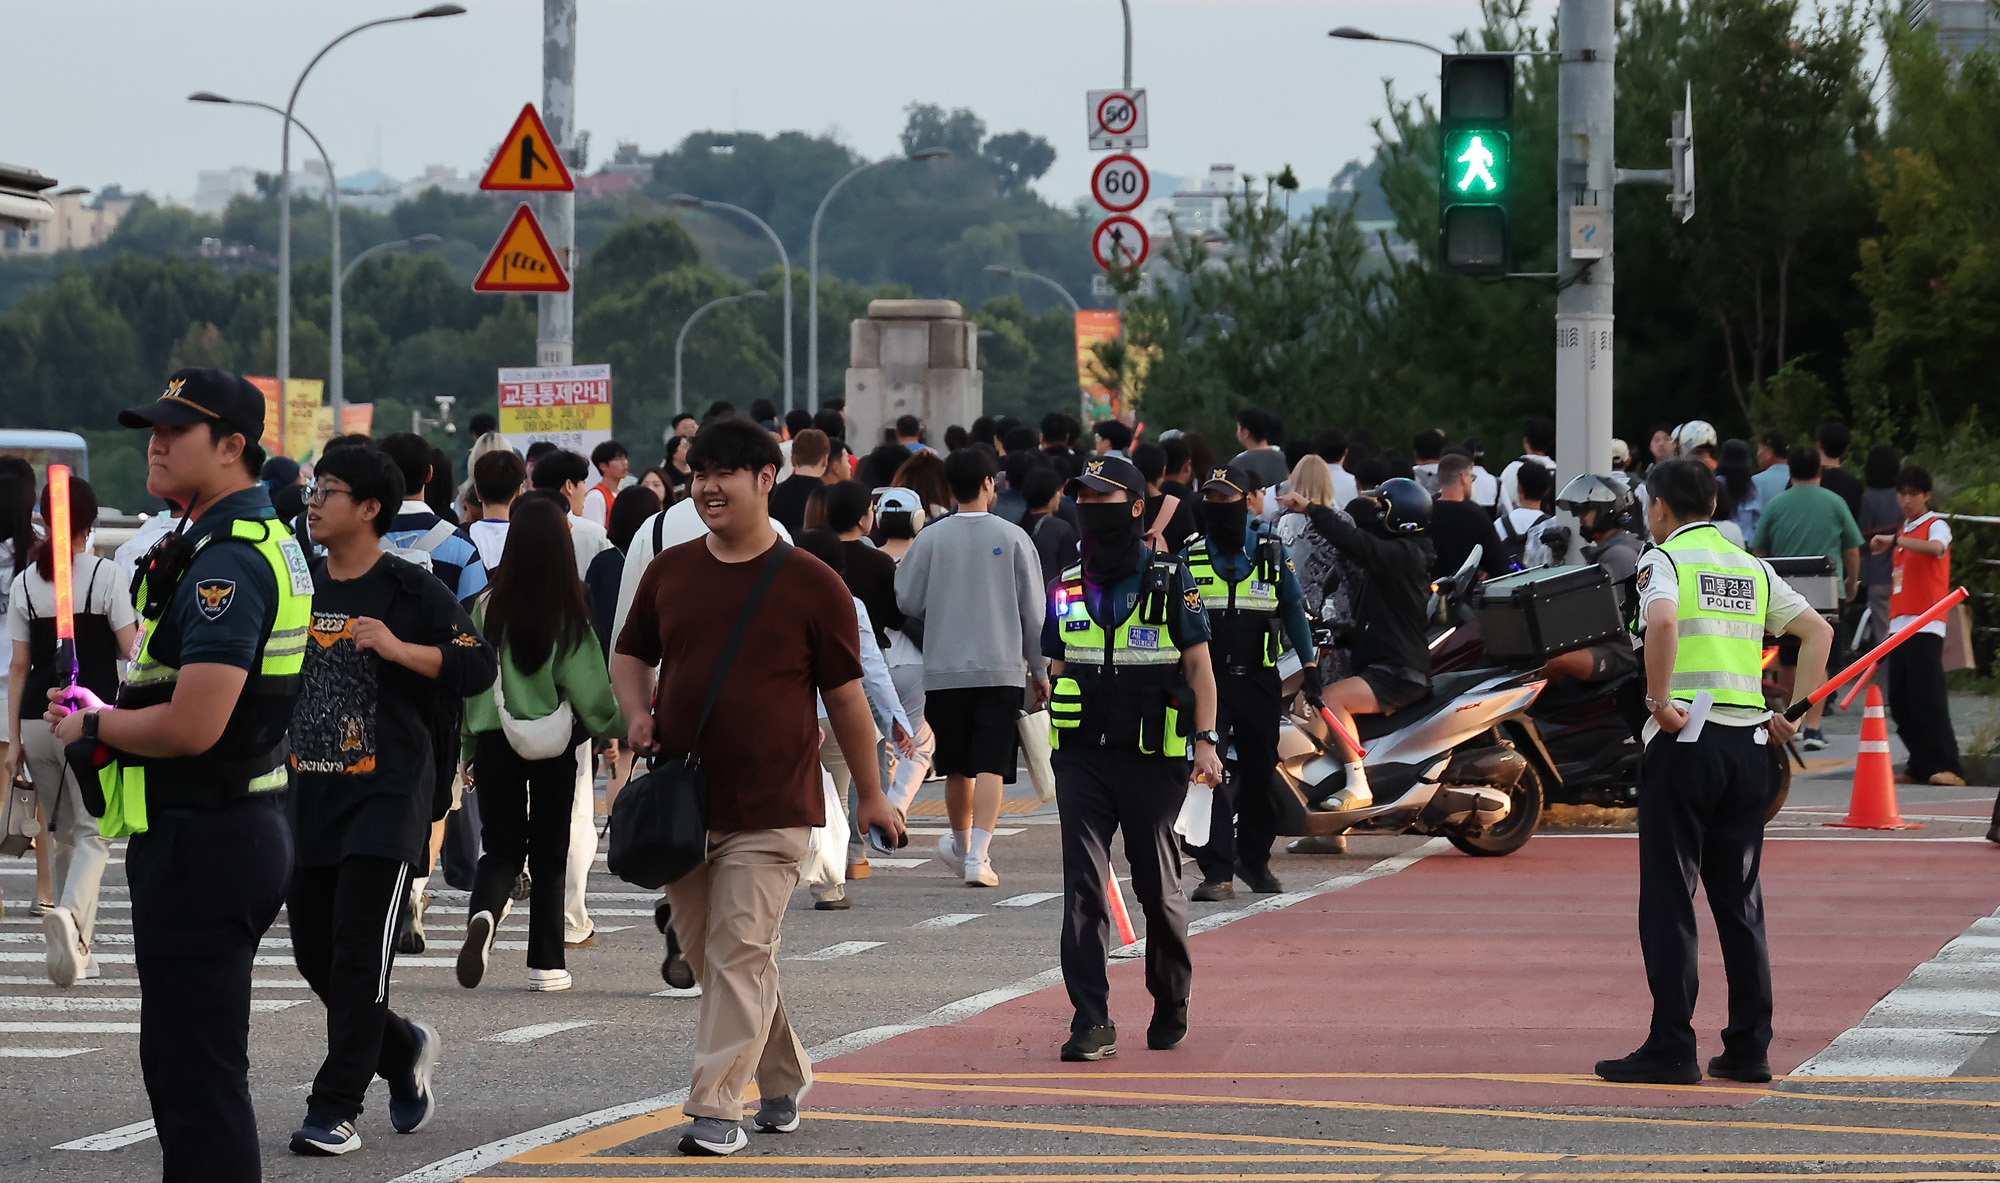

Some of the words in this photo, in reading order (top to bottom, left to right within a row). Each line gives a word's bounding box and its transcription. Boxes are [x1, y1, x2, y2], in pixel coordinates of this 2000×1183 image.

[1105, 170, 1136, 193] 60
[503, 382, 608, 406] 교통통제안내
[1704, 577, 1752, 598] 교통경찰
[1707, 597, 1752, 610] POLICE
[297, 758, 344, 772] seniors
